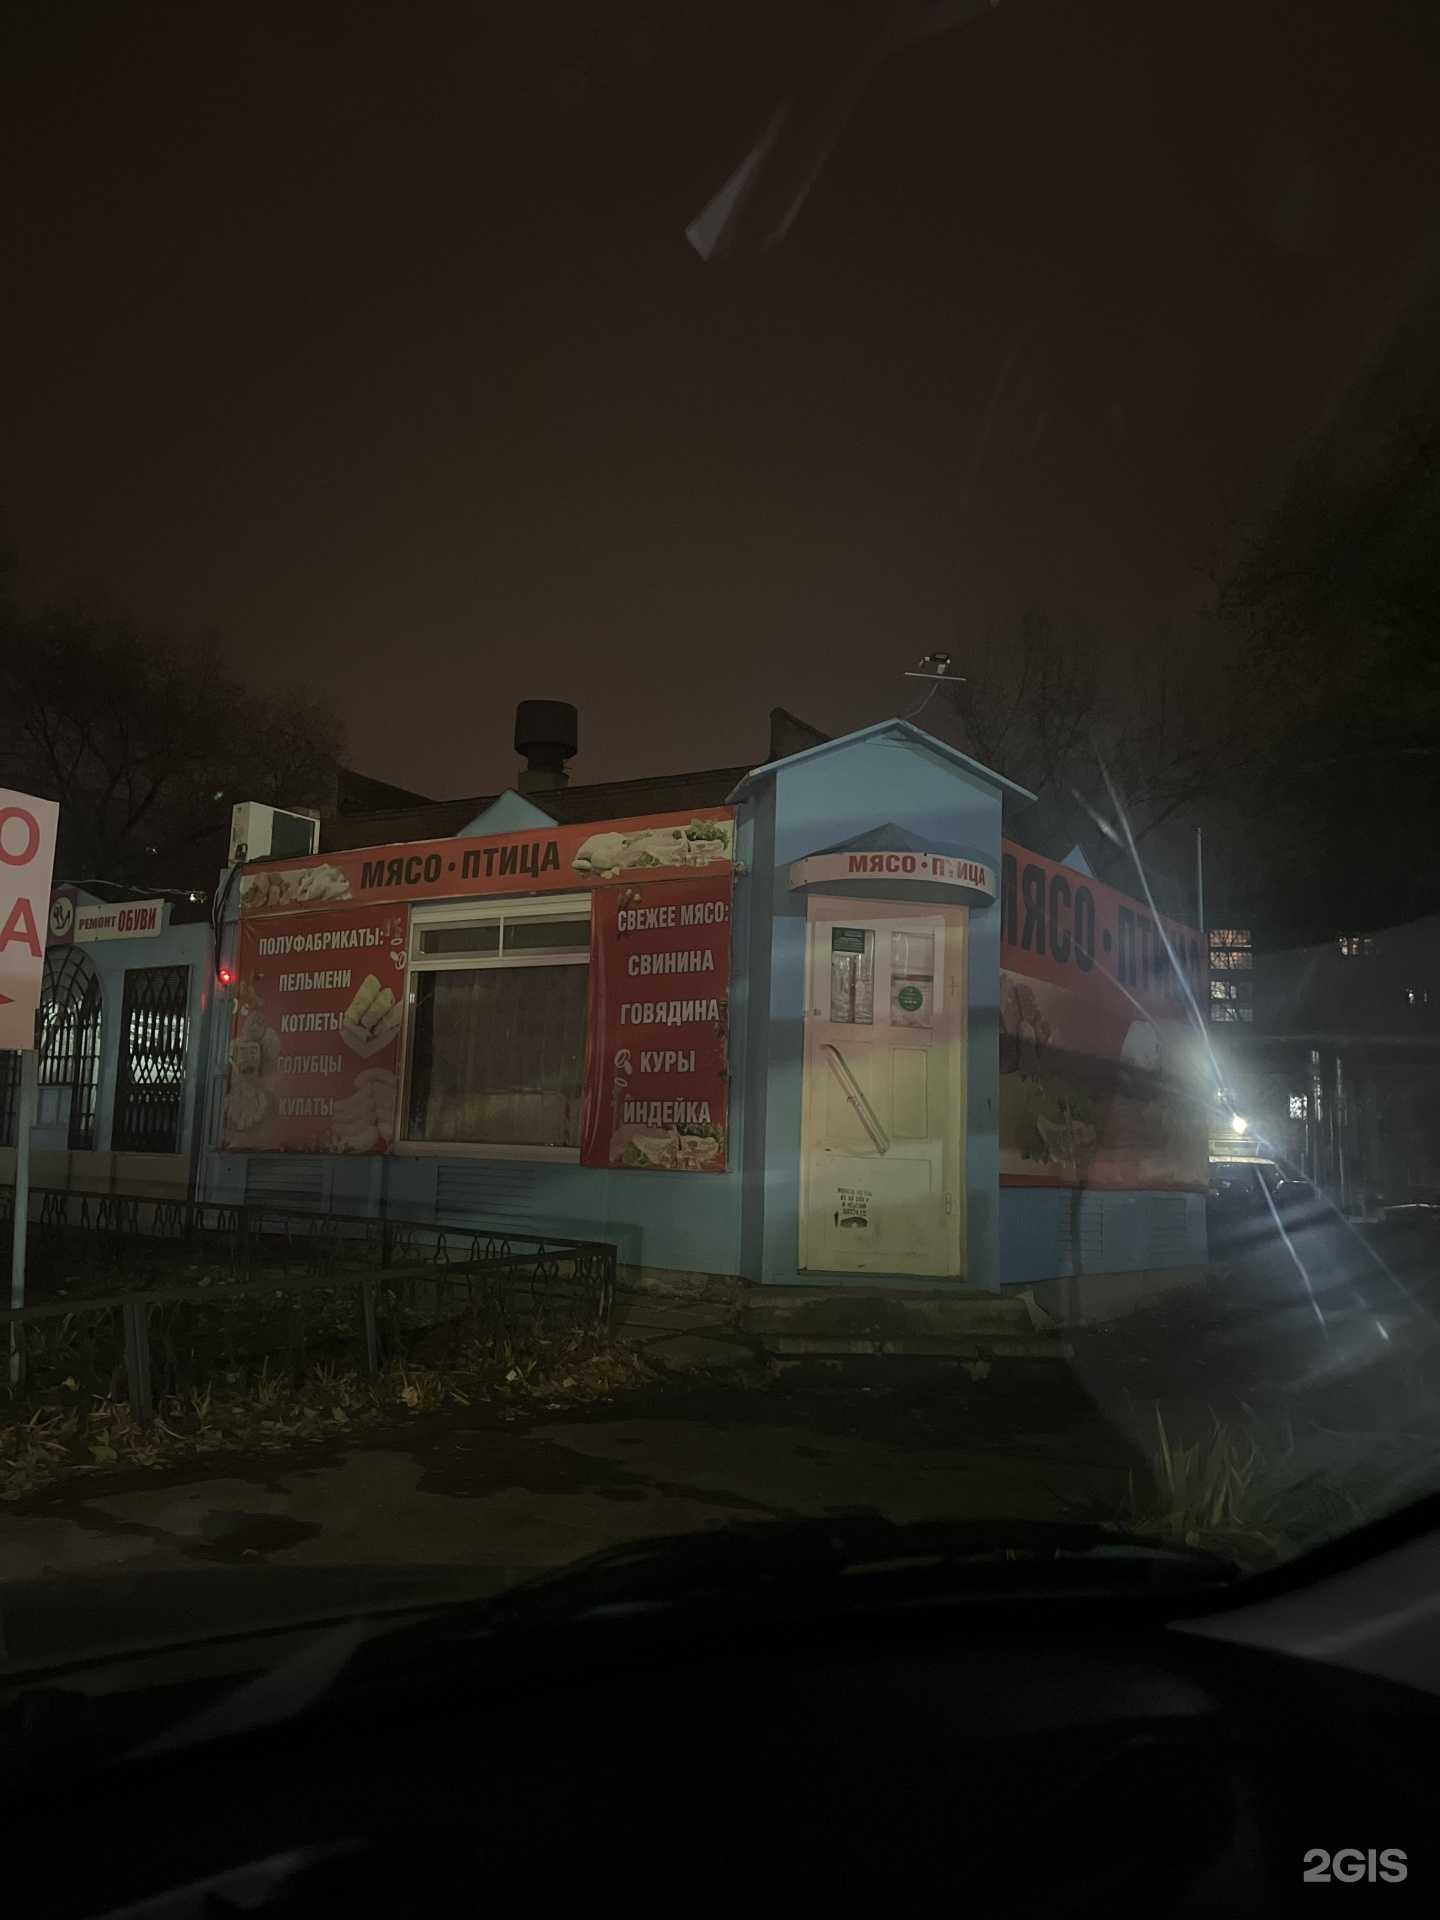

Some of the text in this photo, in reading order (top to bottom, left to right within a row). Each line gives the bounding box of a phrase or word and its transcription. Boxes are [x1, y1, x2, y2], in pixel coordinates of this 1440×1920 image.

[360, 841, 560, 889] МЯСО ПТИЦА
[848, 854, 986, 886] МЯСО ПИЦА
[118, 907, 157, 932] ОБУВИ
[618, 900, 729, 932] СВЕЖЕЕ МЯСО:
[258, 927, 384, 956] ПОЛУФАБРИКАТЫ:
[628, 950, 715, 977] СВИНИНА
[279, 969, 352, 992] ПЕЛЬМЕНИ
[280, 1012, 344, 1033] КОТЛЕТЫ
[620, 999, 720, 1026] ГОВЯДИНА
[640, 1050, 696, 1073] КУРЫ
[623, 1097, 712, 1127] ИНДЕЙКА
